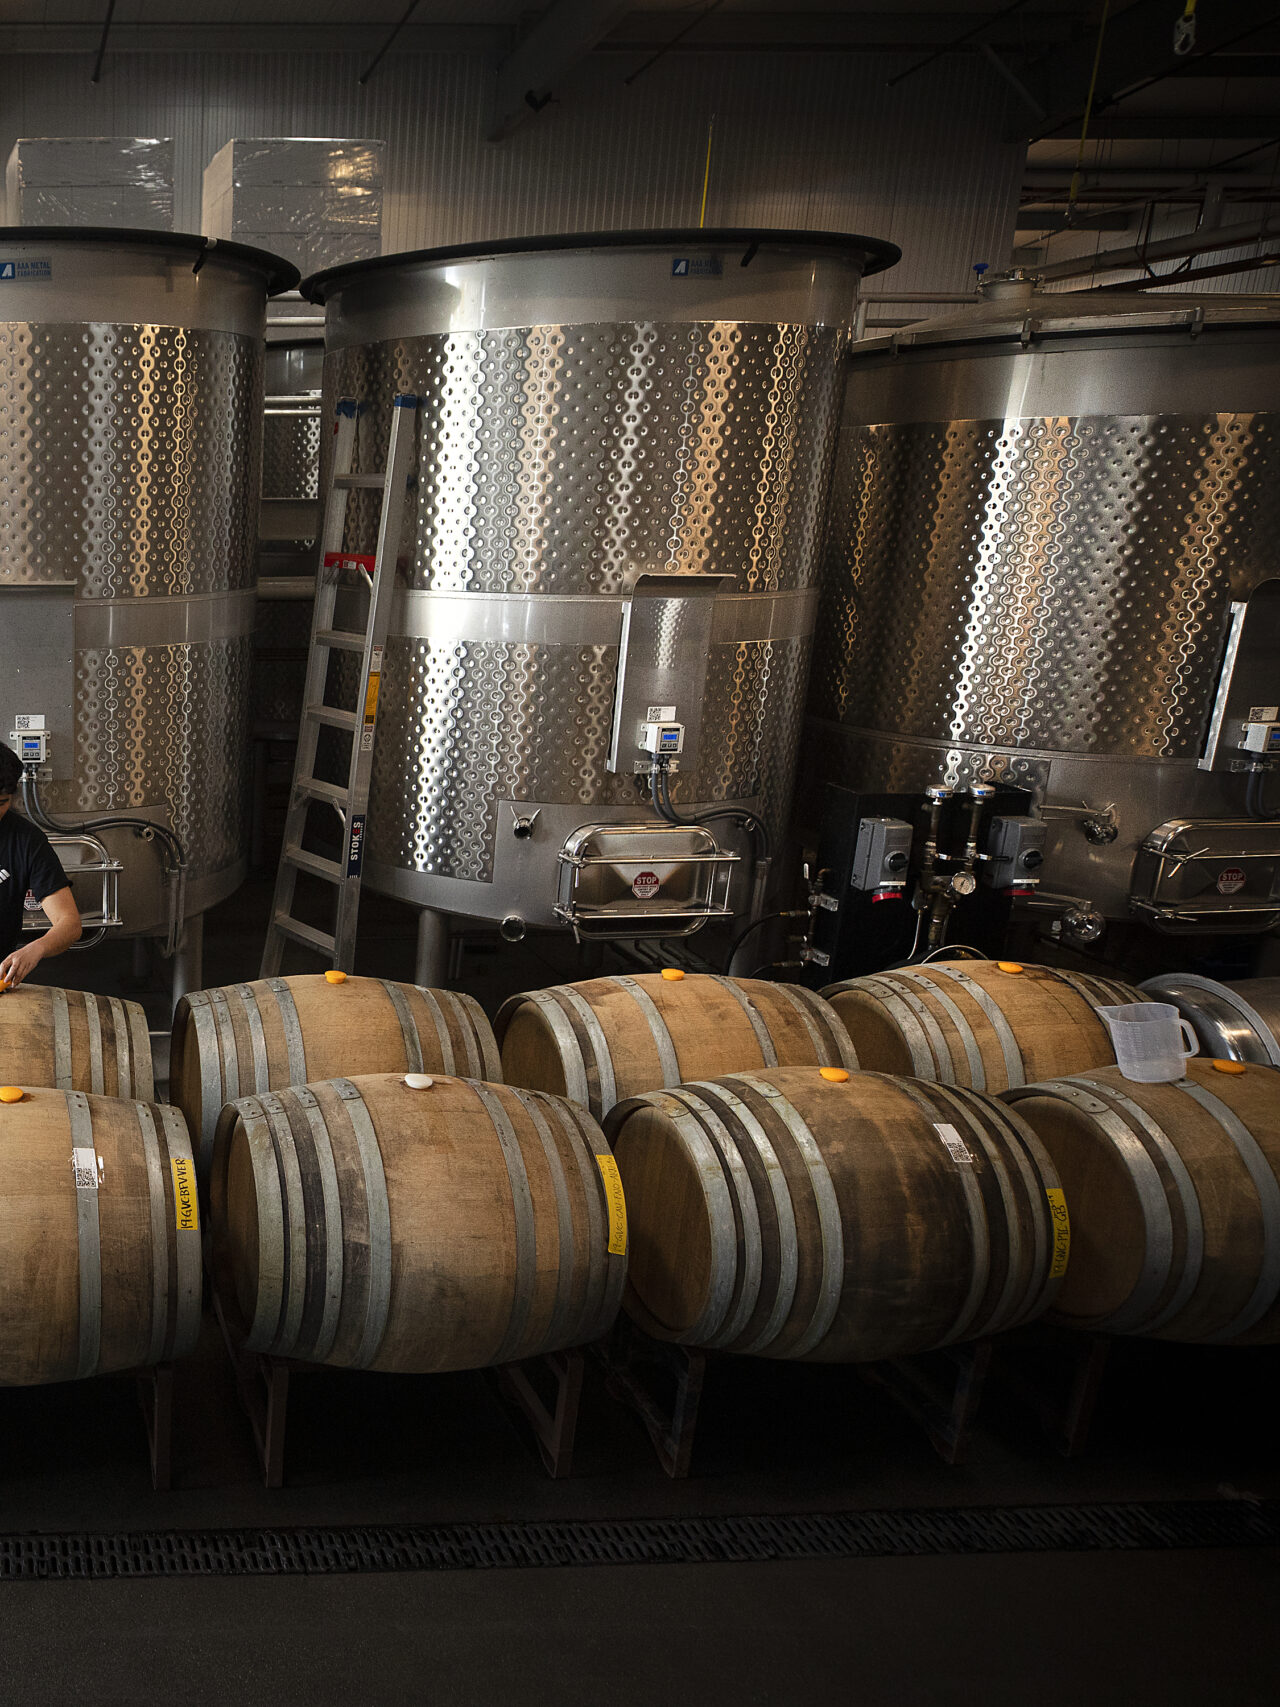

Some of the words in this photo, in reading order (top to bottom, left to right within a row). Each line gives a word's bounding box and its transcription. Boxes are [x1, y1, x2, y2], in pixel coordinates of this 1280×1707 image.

[31, 261, 50, 269] METAL
[350, 821, 361, 861] STOKES
[636, 876, 657, 885] STOP
[1222, 873, 1243, 881] STOP
